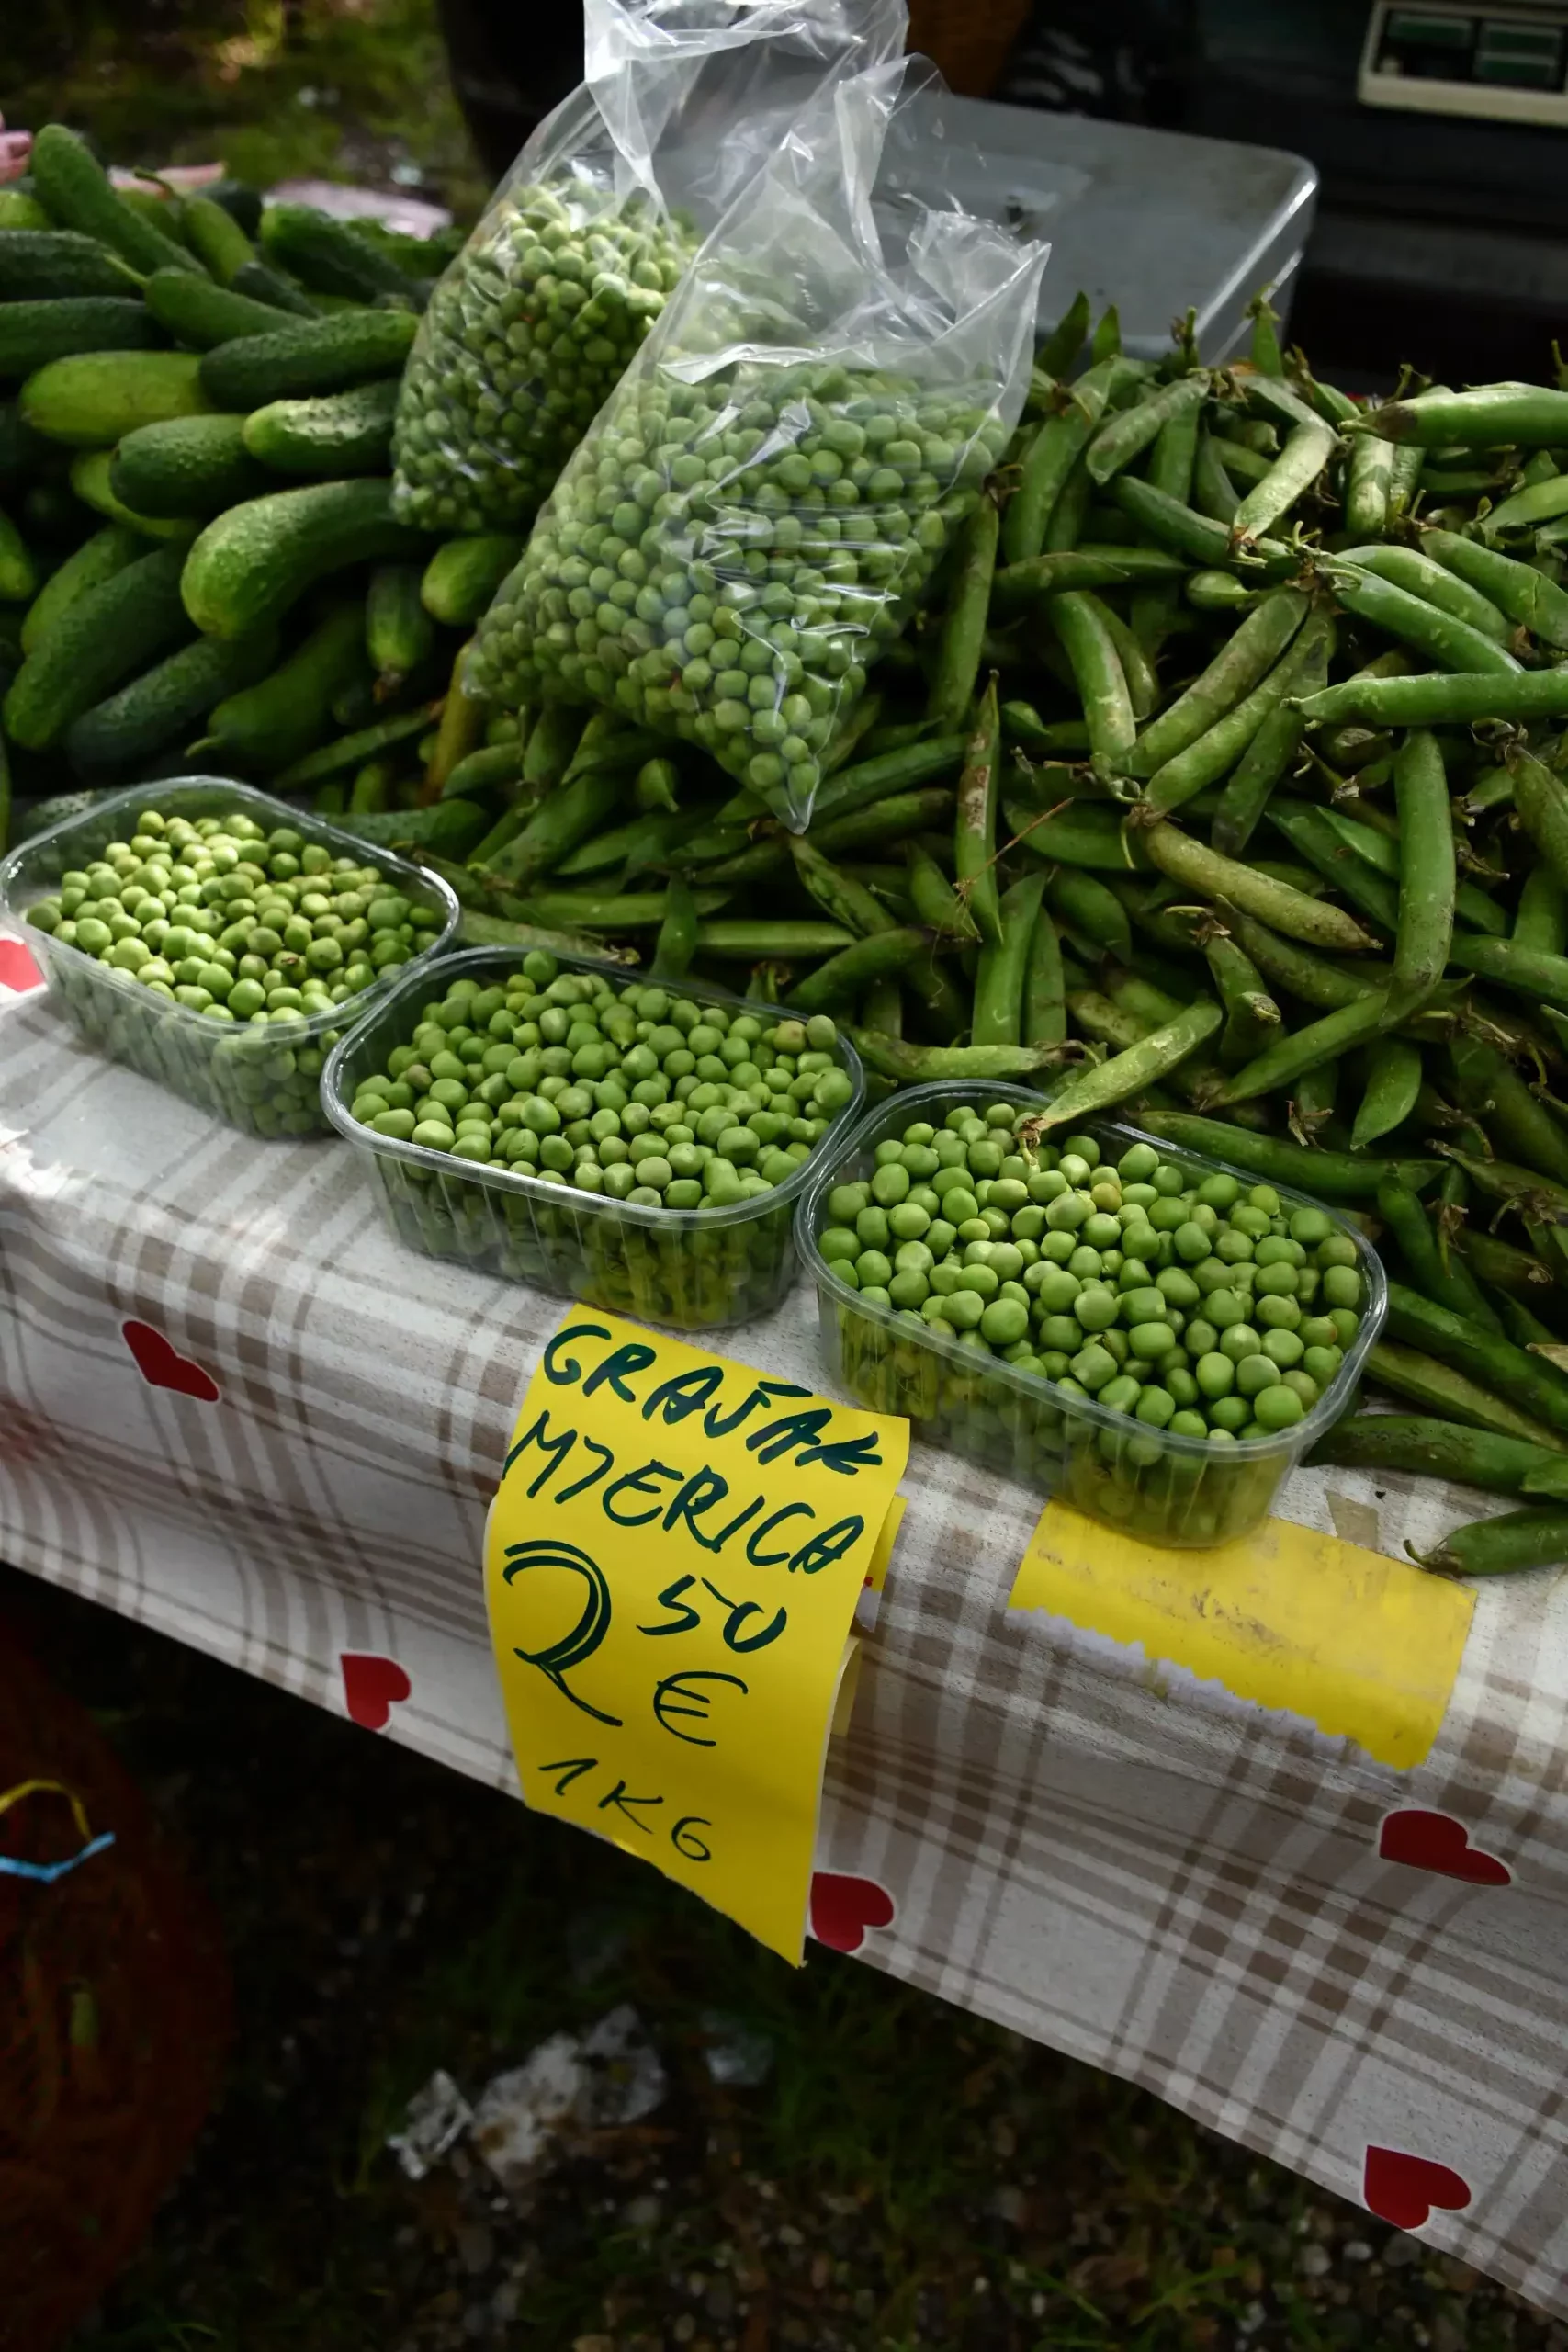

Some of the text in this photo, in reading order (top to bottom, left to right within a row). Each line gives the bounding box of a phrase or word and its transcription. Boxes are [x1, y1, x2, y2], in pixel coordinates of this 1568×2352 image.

[502, 1409, 865, 1575] MJERICA
[503, 1539, 788, 1727] 2 50
[653, 1670, 749, 1747] €
[538, 1758, 712, 1862] 1 KG
